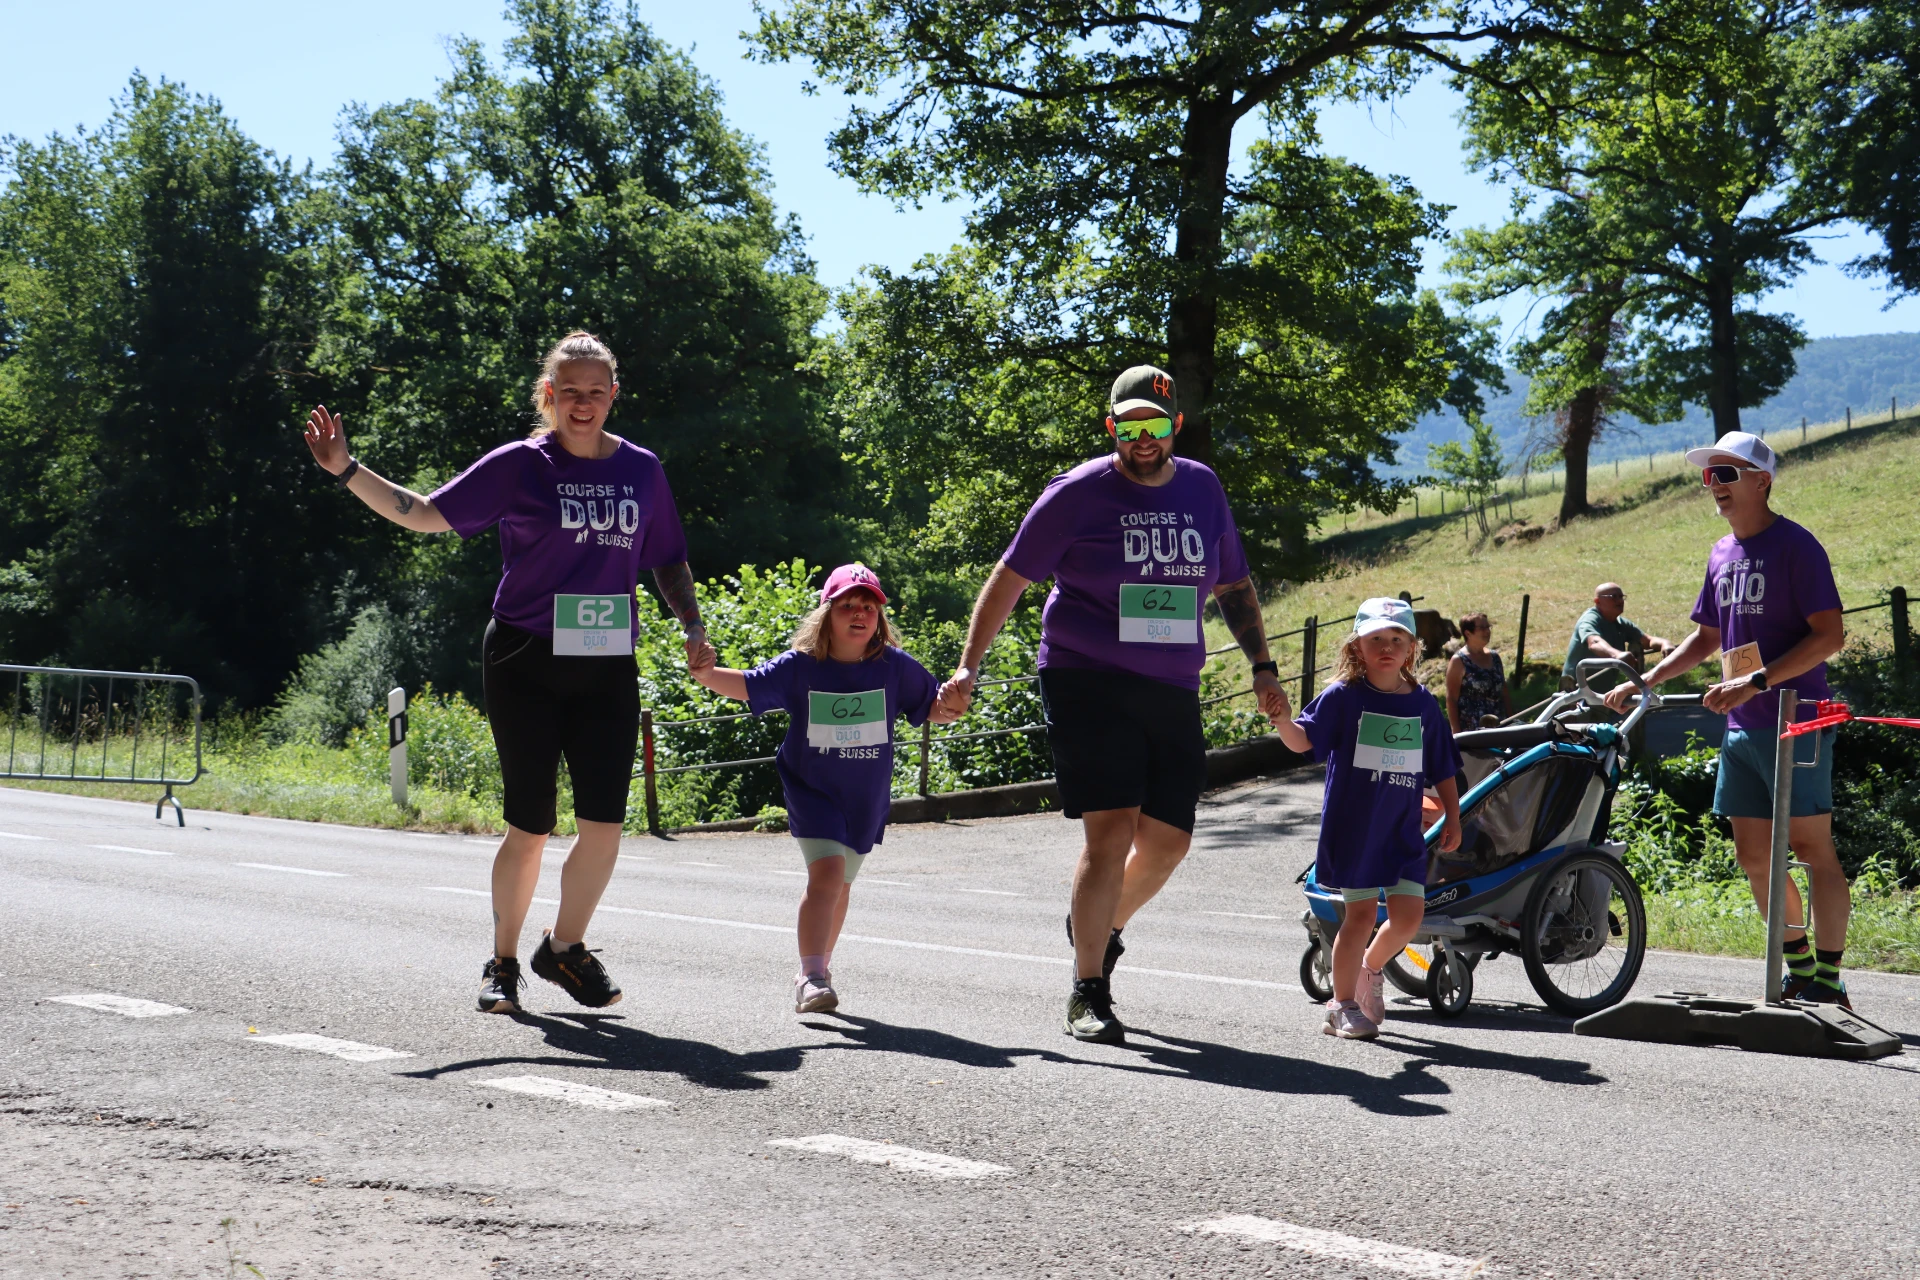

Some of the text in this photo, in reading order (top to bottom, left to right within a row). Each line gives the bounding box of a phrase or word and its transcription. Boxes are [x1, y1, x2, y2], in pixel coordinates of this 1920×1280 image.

[556, 483, 616, 497] COURSE
[560, 498, 639, 535] DUO
[1120, 512, 1178, 527] COURSE
[597, 533, 634, 550] SUISSE
[1123, 528, 1205, 563] DUO
[1163, 565, 1206, 577] SUISSE
[1718, 573, 1765, 608] DUO
[1142, 588, 1177, 612] 62
[577, 599, 615, 627] 62
[1147, 624, 1171, 636] DUO
[583, 635, 608, 647] DUO
[831, 696, 866, 719] 62
[835, 730, 861, 741] DUO
[1383, 722, 1413, 744] 62
[838, 747, 880, 759] SUISSE
[1381, 754, 1406, 765] DUO
